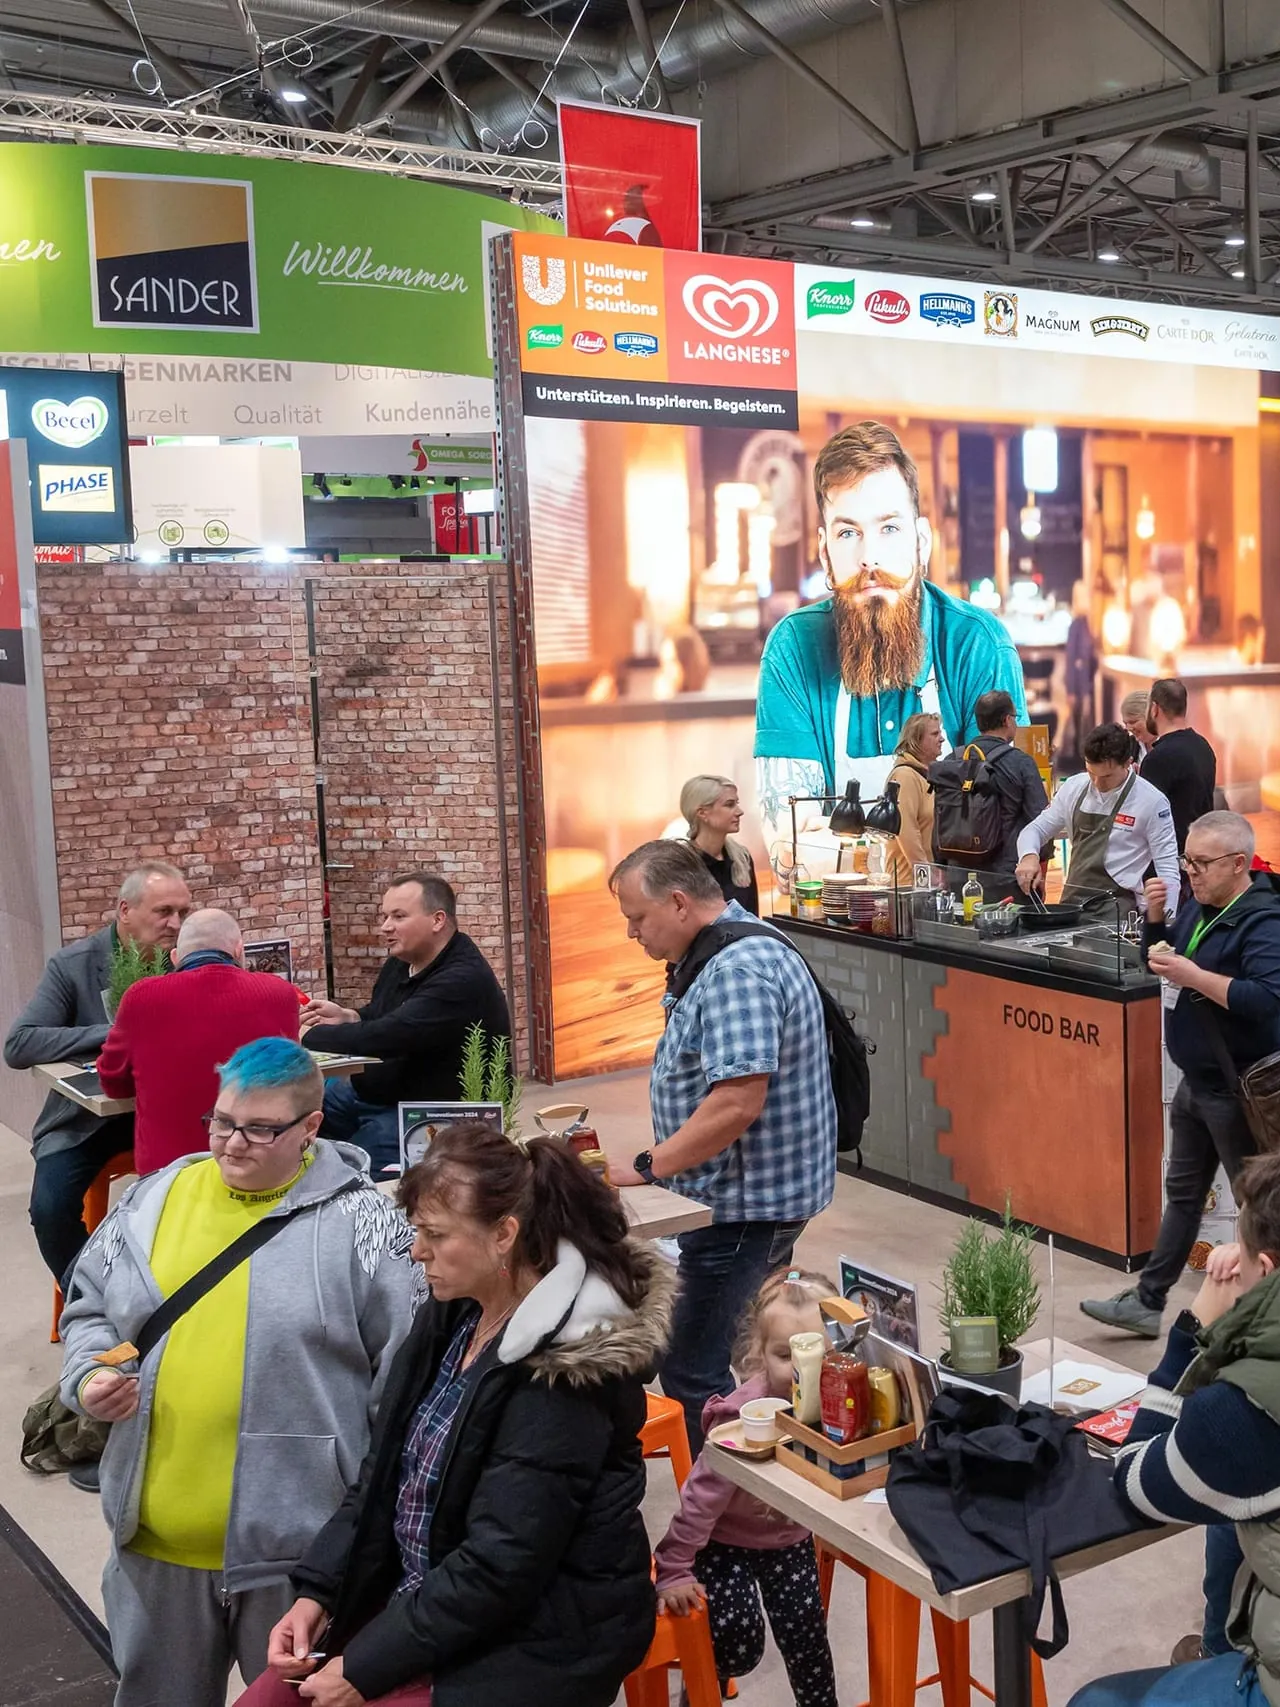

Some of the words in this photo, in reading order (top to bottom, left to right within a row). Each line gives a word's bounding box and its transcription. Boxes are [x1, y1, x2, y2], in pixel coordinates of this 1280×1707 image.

[282, 241, 469, 295] Willkommen
[583, 261, 648, 282] Unilever
[110, 275, 241, 316] SANDER
[584, 280, 624, 297] Food
[809, 288, 855, 306] Knorr
[585, 297, 659, 317] Solutions
[922, 297, 973, 316] HELLMANN'S
[1025, 314, 1081, 333] MAGNUM
[1157, 325, 1187, 341] CARTE
[1224, 321, 1279, 343] Gelateria
[528, 327, 563, 342] Knorr
[536, 387, 635, 406] Unterstützen.
[635, 393, 712, 412] Inspirieren.
[713, 398, 786, 415] Begeistern.
[45, 411, 96, 430] Becel
[234, 404, 323, 425] Qualität
[366, 400, 491, 423] Kundennähe
[431, 449, 465, 458] OMEGA
[45, 472, 109, 502] PHASE
[1003, 1004, 1054, 1034] FOOD
[1060, 1016, 1100, 1047] BAR
[229, 1191, 246, 1202] Los
